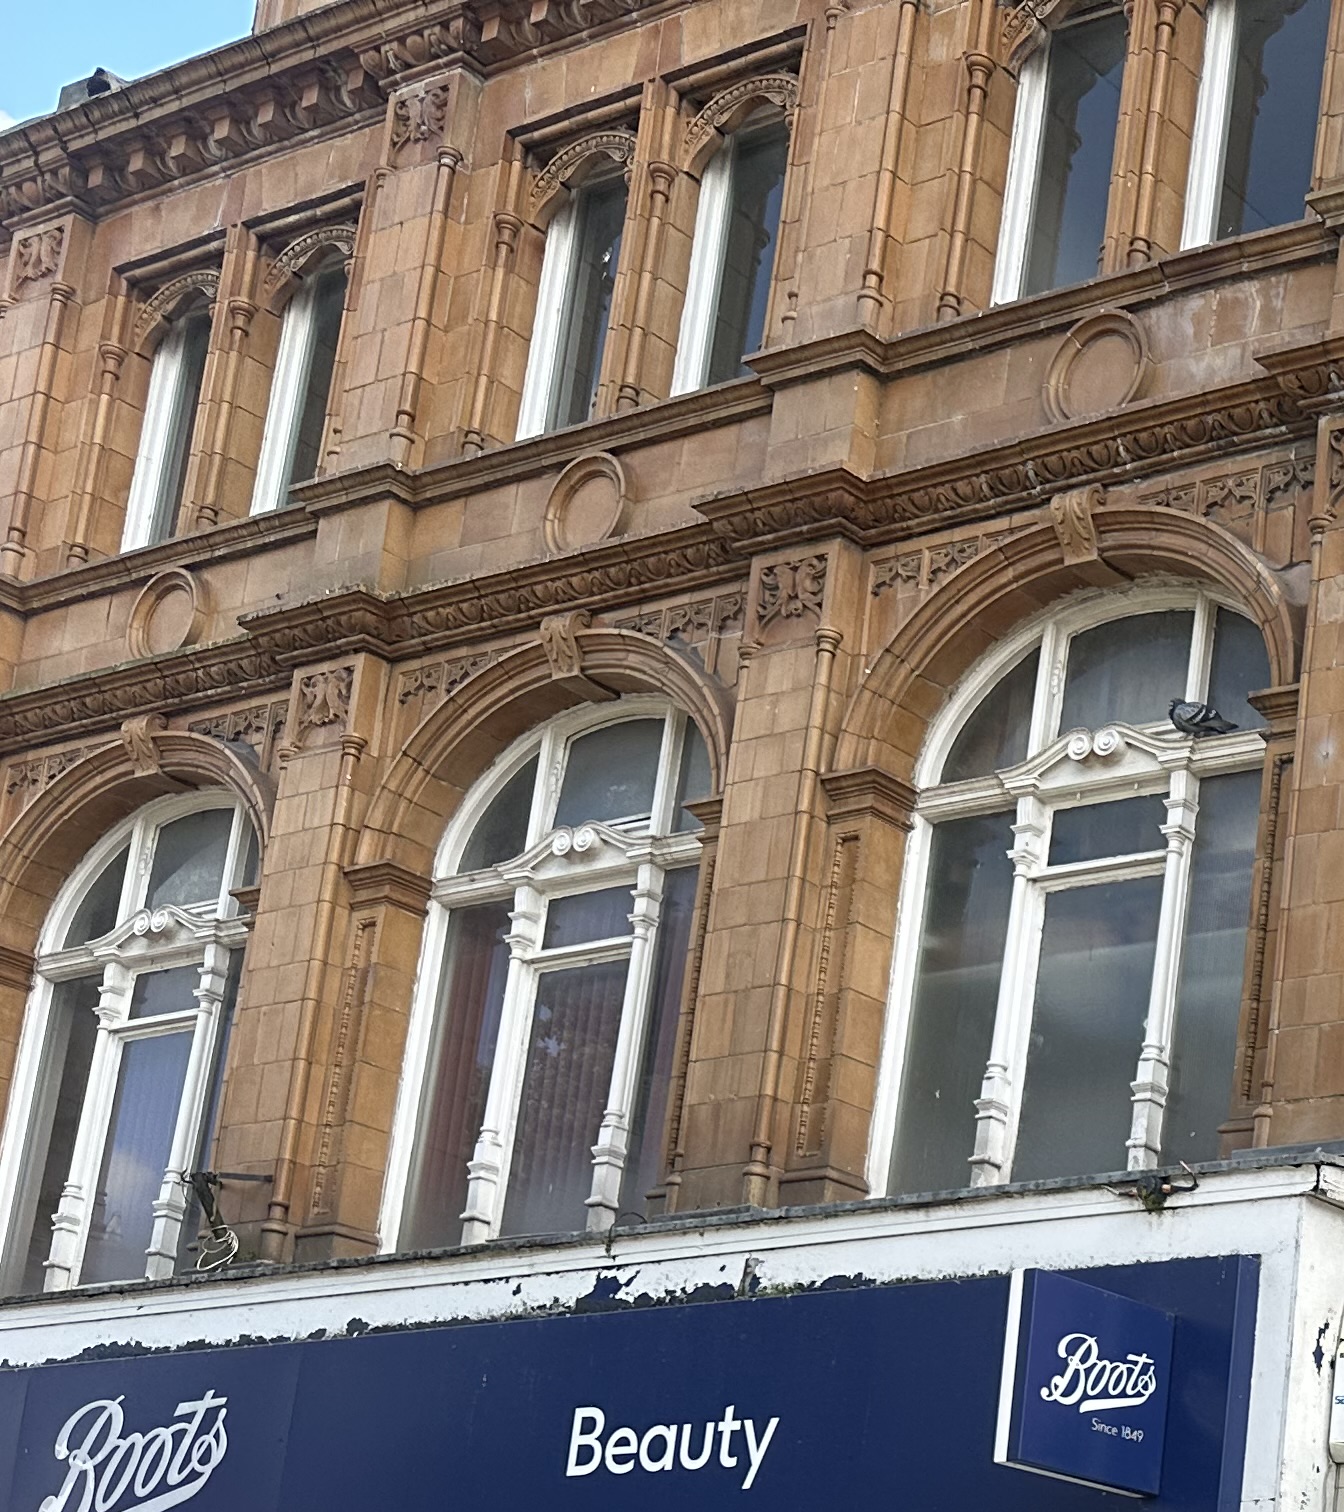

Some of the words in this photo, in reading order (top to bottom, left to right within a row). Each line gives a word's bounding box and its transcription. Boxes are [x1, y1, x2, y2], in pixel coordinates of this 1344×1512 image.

[1039, 1332, 1157, 1414] Boots
[566, 1404, 780, 1490] Beauty
[1091, 1416, 1119, 1438] Since
[1121, 1422, 1144, 1444] 1849
